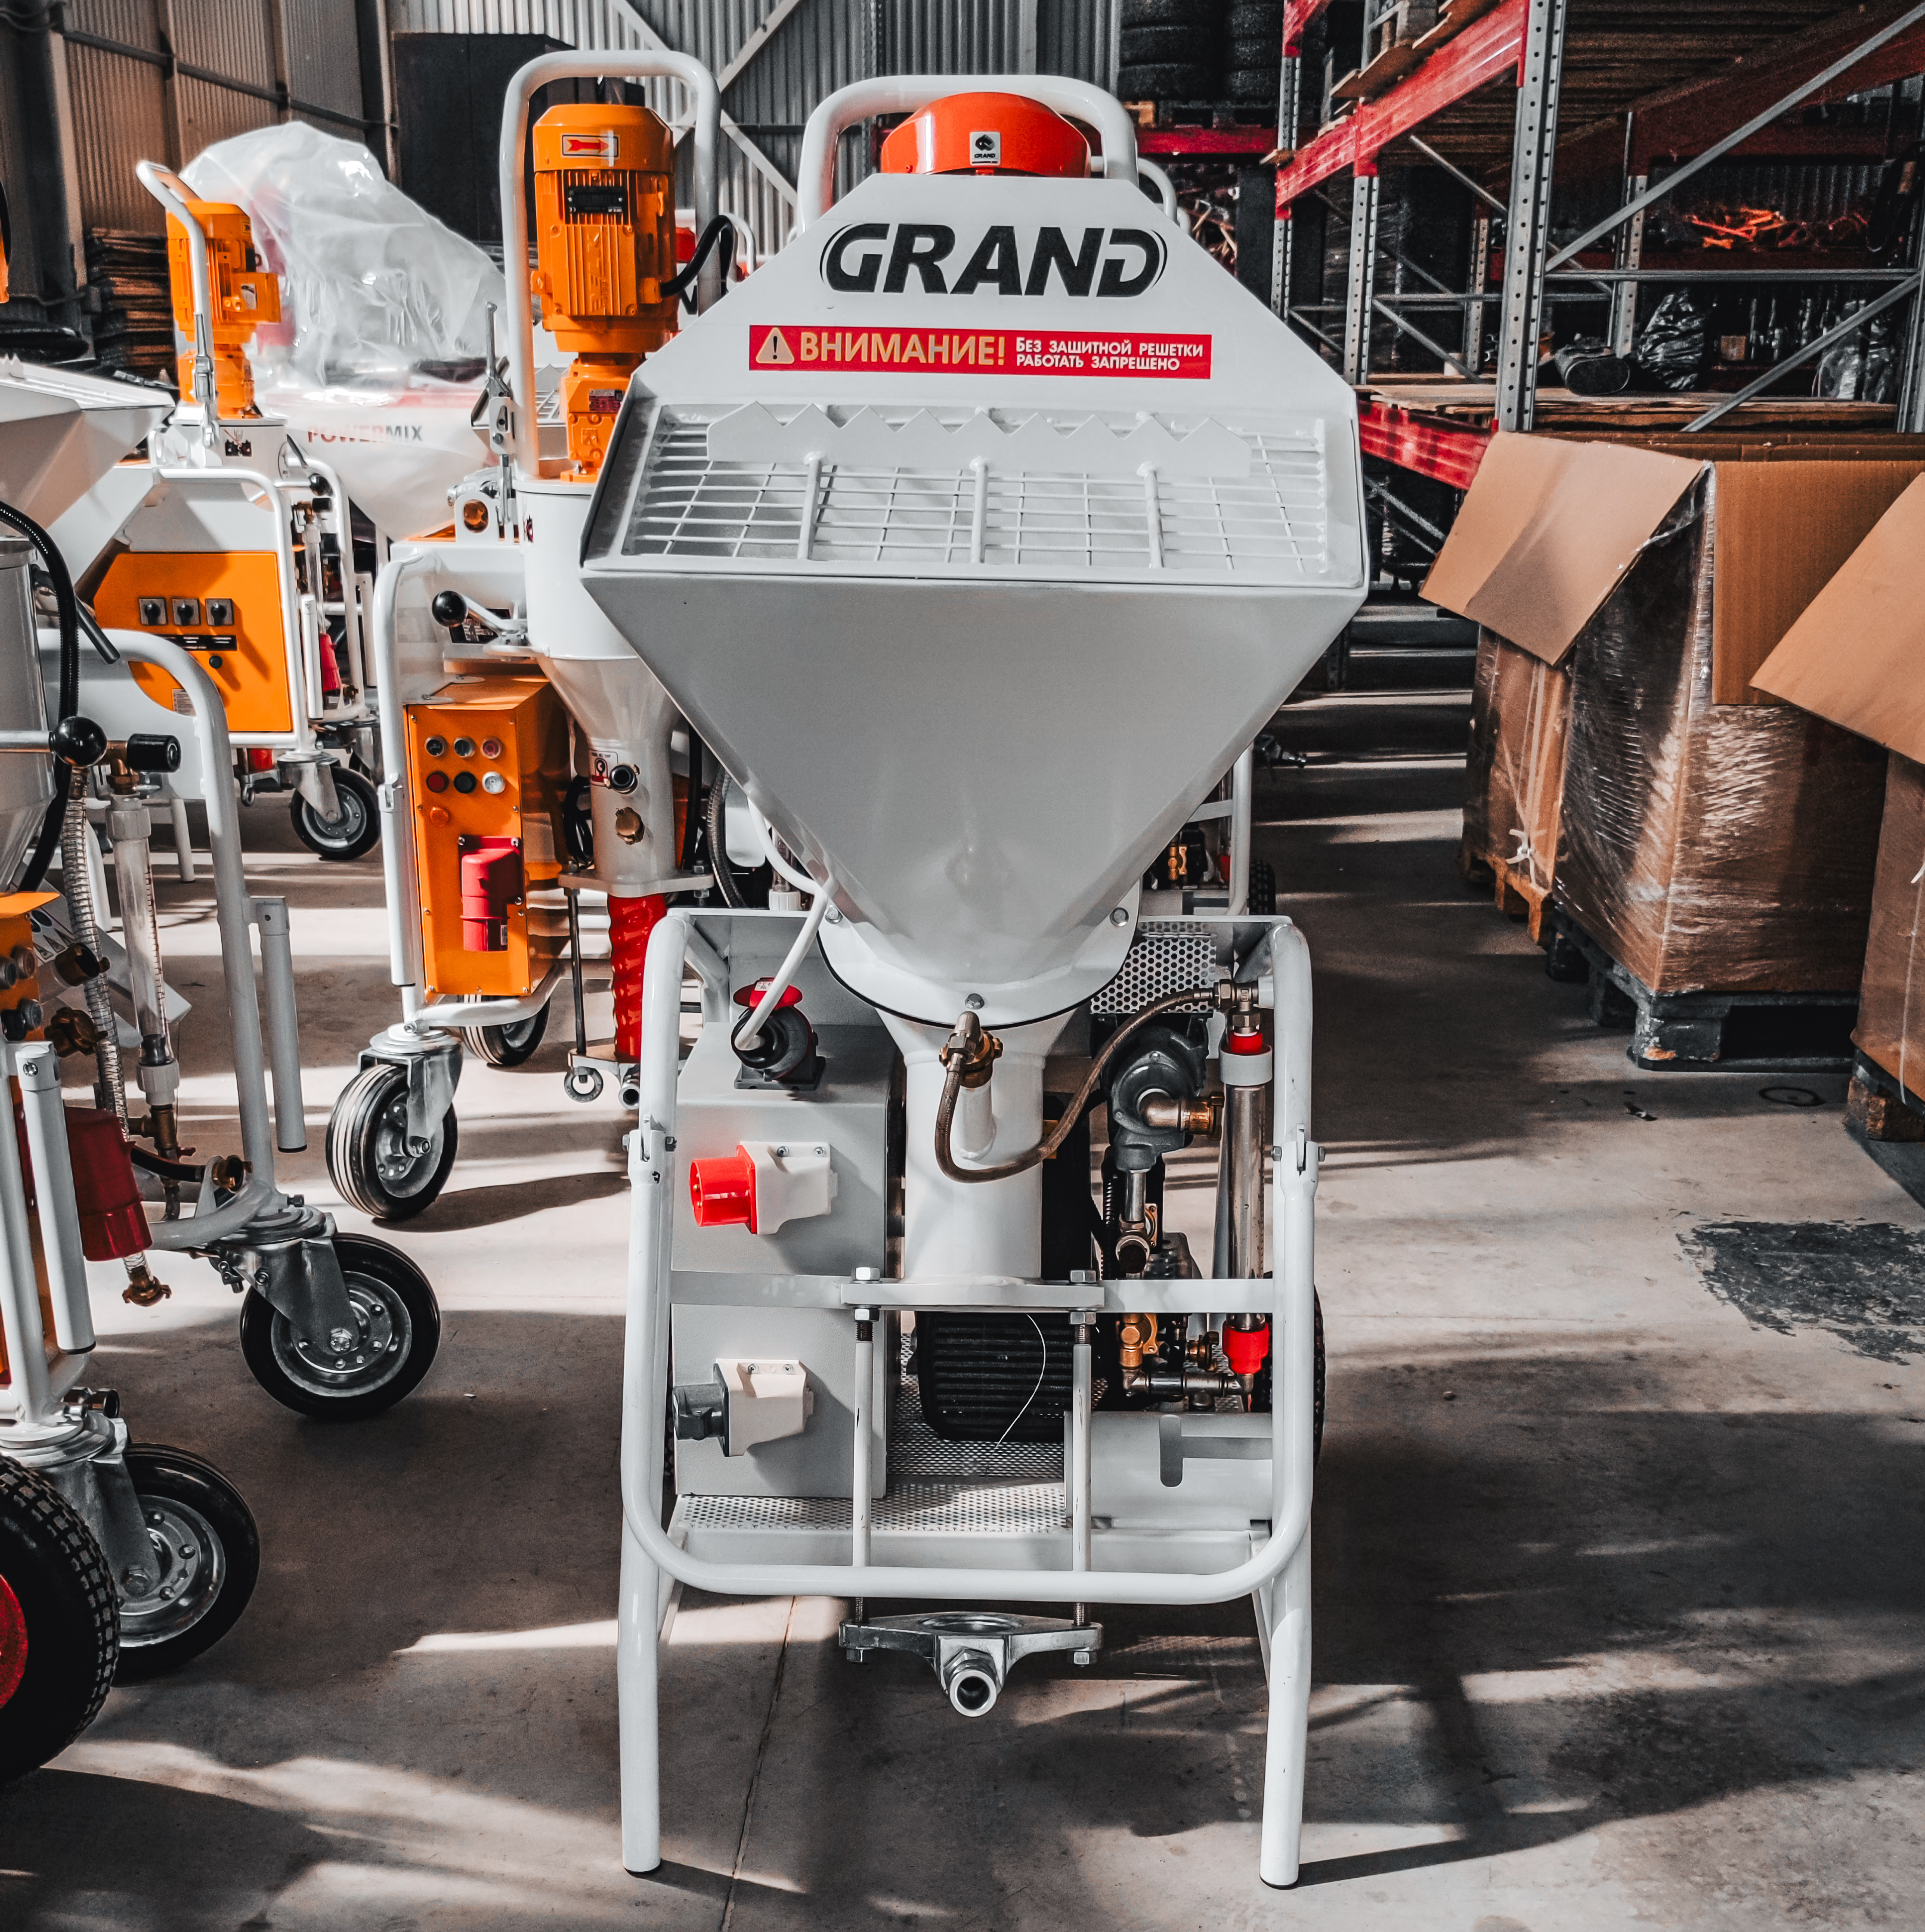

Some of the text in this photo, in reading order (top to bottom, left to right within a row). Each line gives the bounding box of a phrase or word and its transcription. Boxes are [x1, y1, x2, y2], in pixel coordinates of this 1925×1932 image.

[819, 222, 1168, 298] GRAND
[800, 332, 1006, 366] ВНИМАНИЕ!
[1016, 336, 1203, 357] БЕЗ ЗАЩИТНОЙ РЕШЕТКИ
[1016, 354, 1180, 371] РАБОТАТЬ ЗАПРЕЩЕНО
